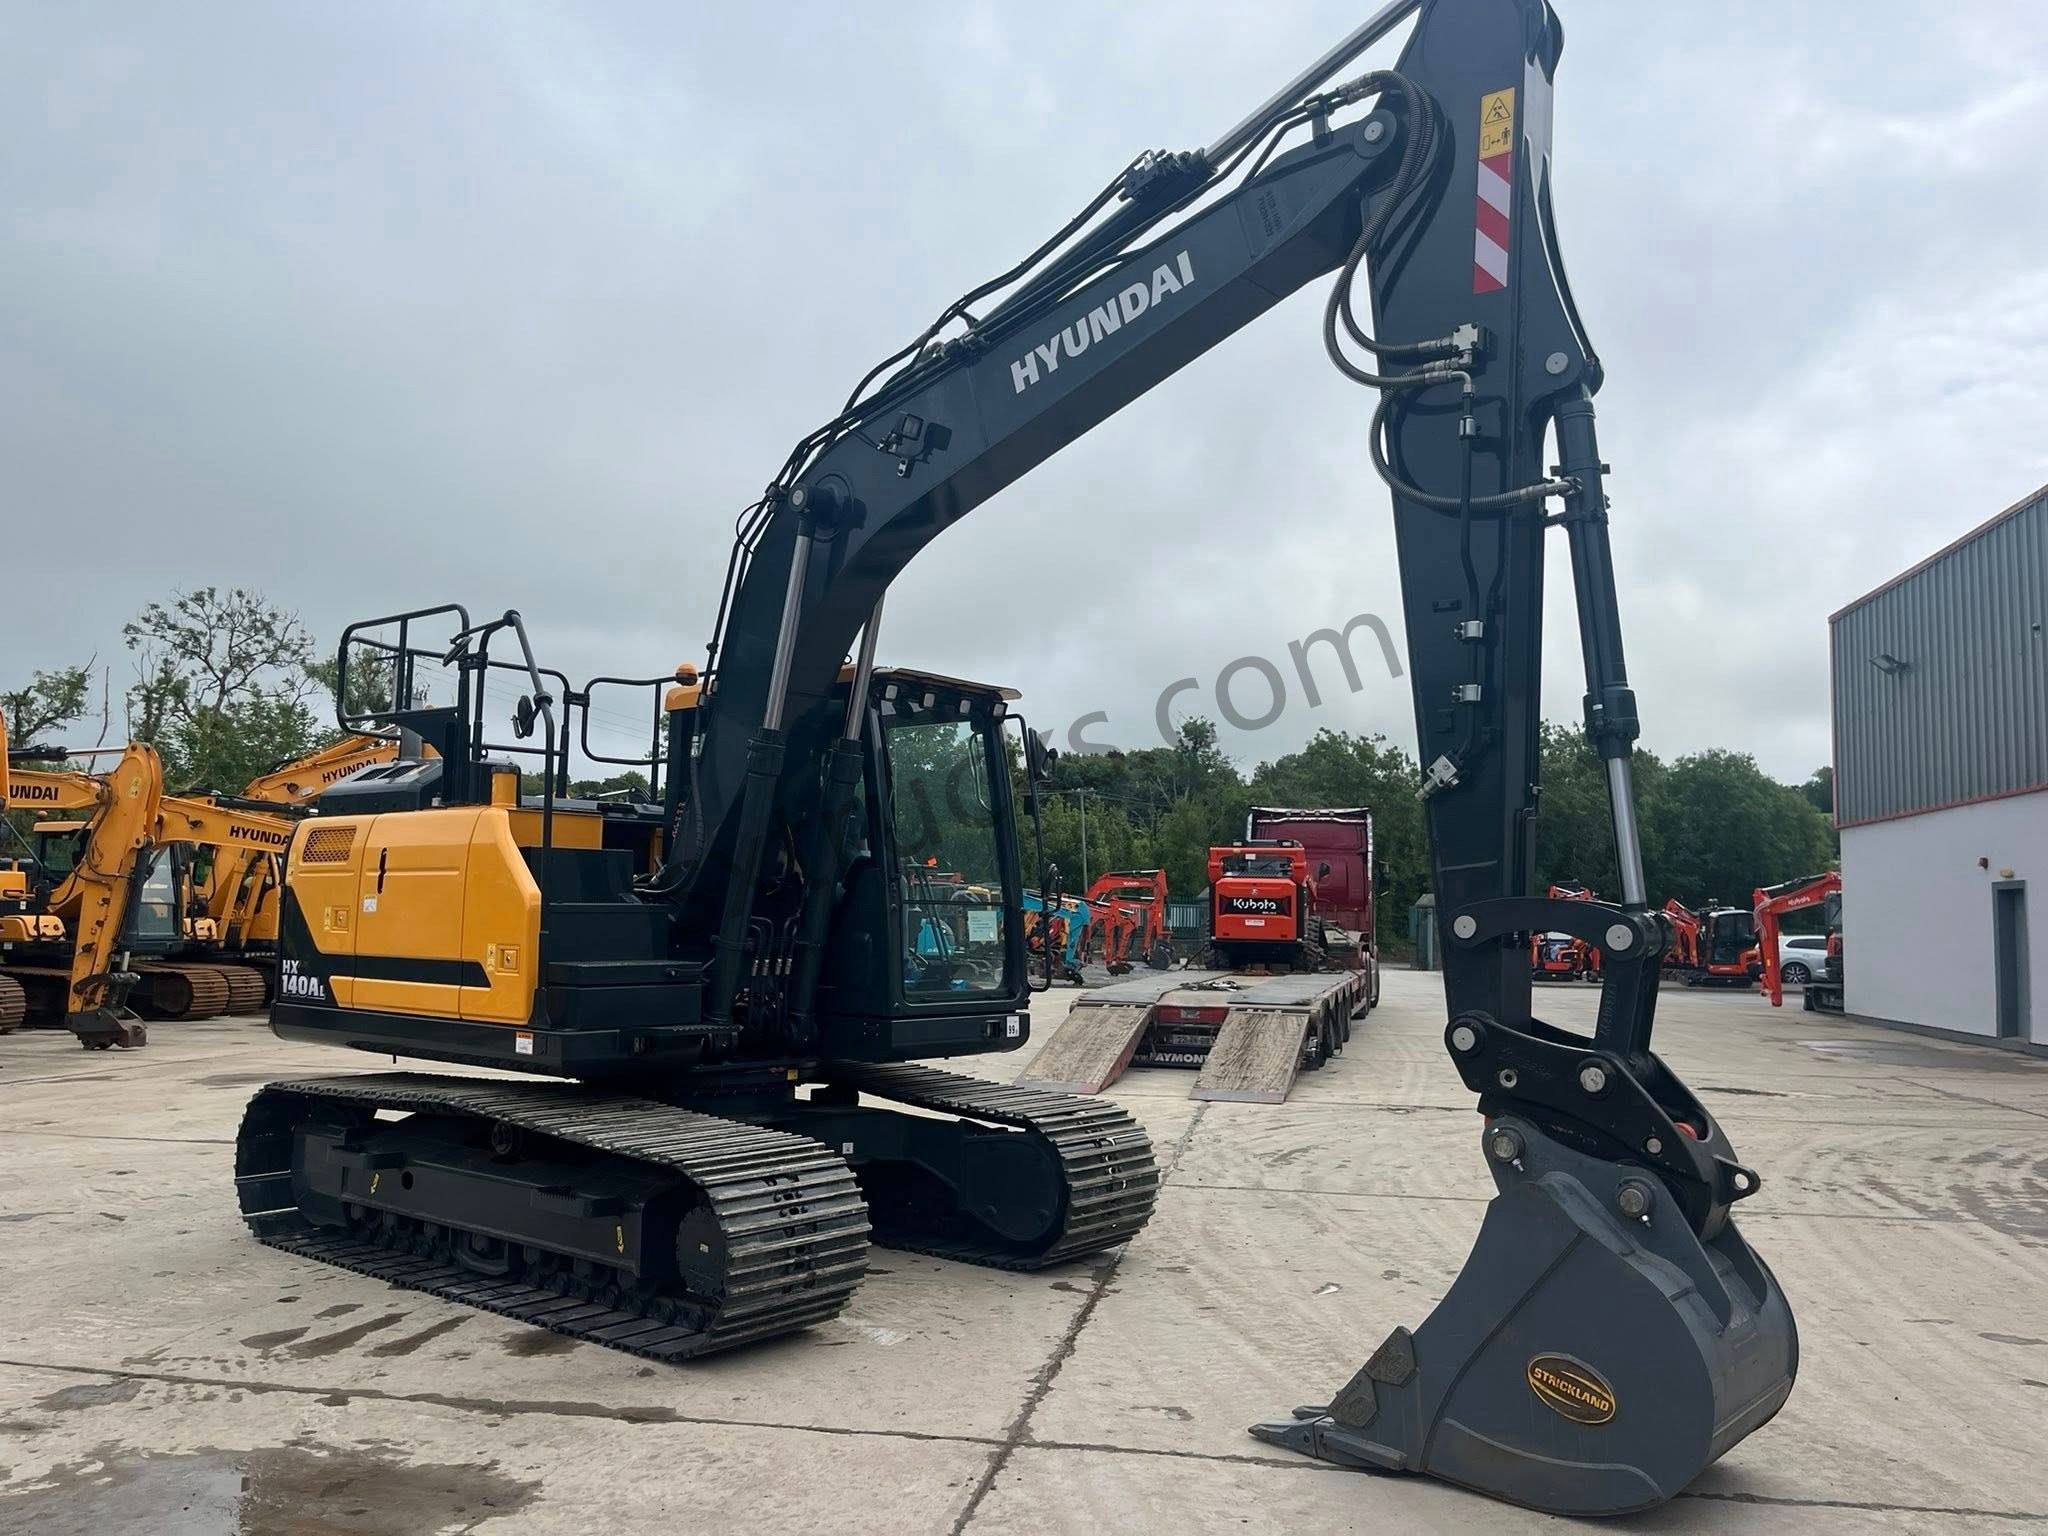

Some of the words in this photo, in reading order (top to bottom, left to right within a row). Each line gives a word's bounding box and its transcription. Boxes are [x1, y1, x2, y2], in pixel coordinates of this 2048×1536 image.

[1010, 249, 1195, 395] HYUNDAI
[9, 784, 59, 801] UNDAI
[229, 825, 290, 847] HYUNDA
[1233, 898, 1277, 910] Kubota
[282, 959, 299, 974] HX
[1533, 1366, 1610, 1412] STRICKLAND
